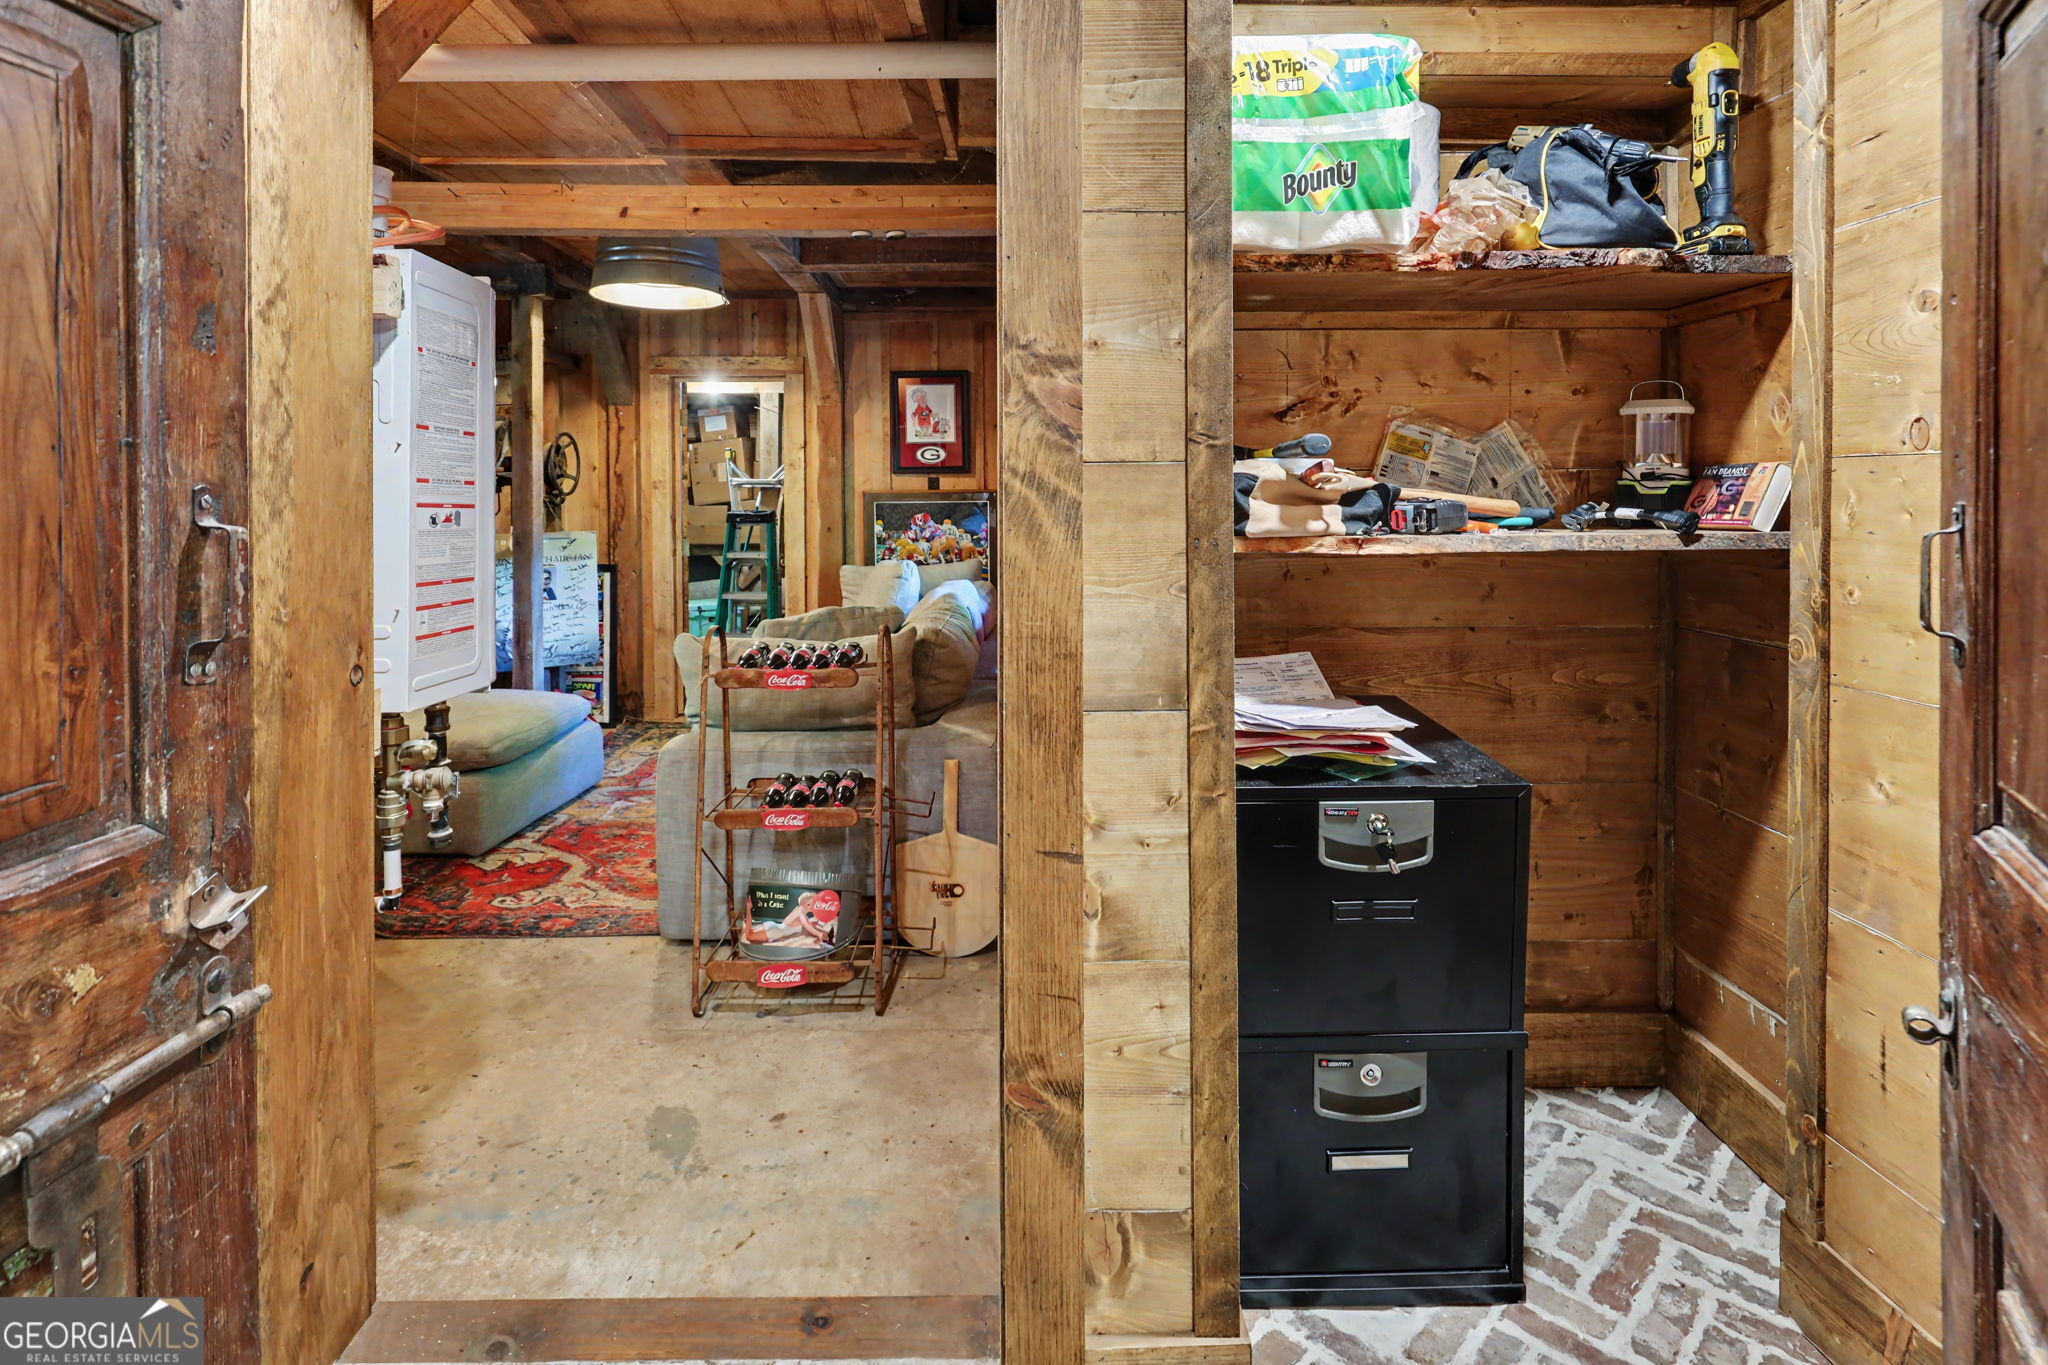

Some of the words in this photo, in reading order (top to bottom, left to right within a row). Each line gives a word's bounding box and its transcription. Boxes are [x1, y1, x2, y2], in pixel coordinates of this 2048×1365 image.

[1243, 60, 1271, 82] 18
[1282, 159, 1357, 205] Bounty
[920, 448, 941, 462] G
[768, 674, 808, 687] Coca-Cola
[765, 813, 806, 827] Coca-Cola
[760, 968, 803, 984] Coca-Cola
